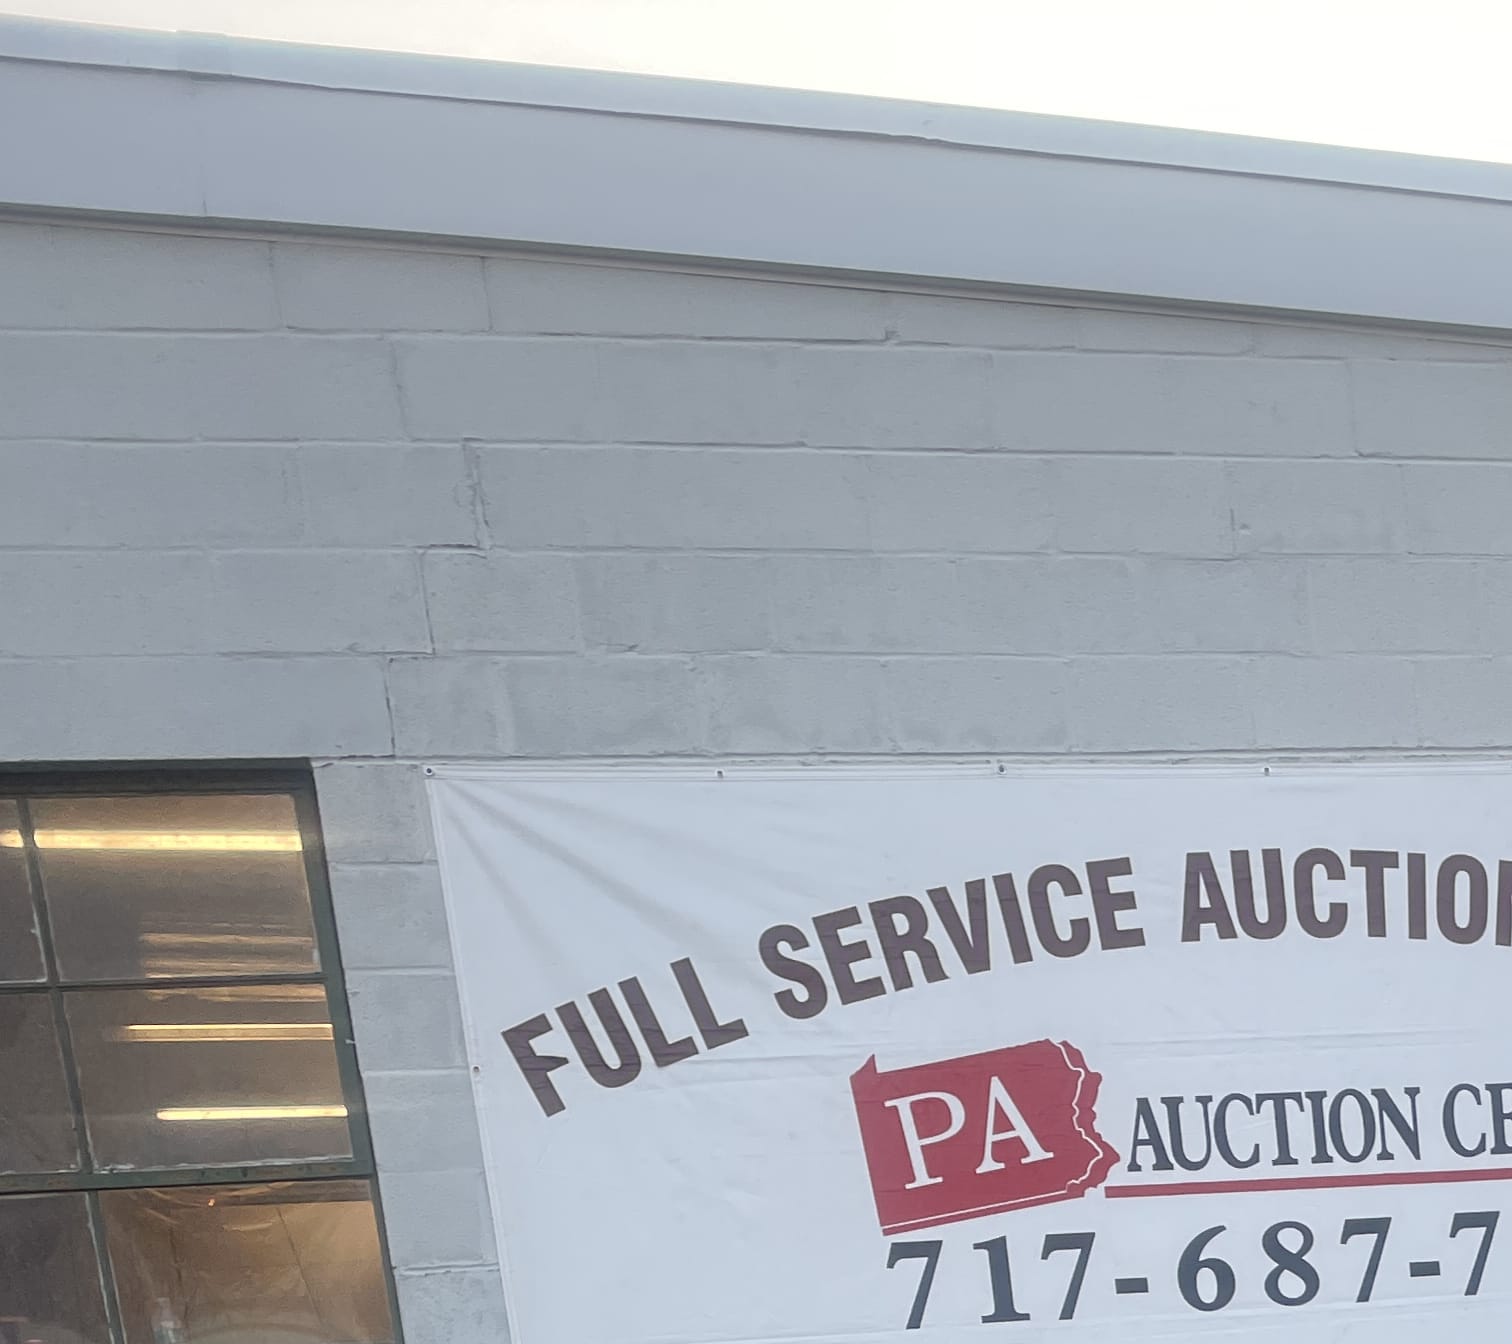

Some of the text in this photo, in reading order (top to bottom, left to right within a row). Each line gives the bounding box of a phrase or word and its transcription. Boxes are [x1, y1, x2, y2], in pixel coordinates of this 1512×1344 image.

[501, 957, 749, 1117] FULL
[758, 857, 1146, 1019] SERVICE
[884, 1076, 1054, 1190] PA
[1127, 1087, 1421, 1172] AUCTION
